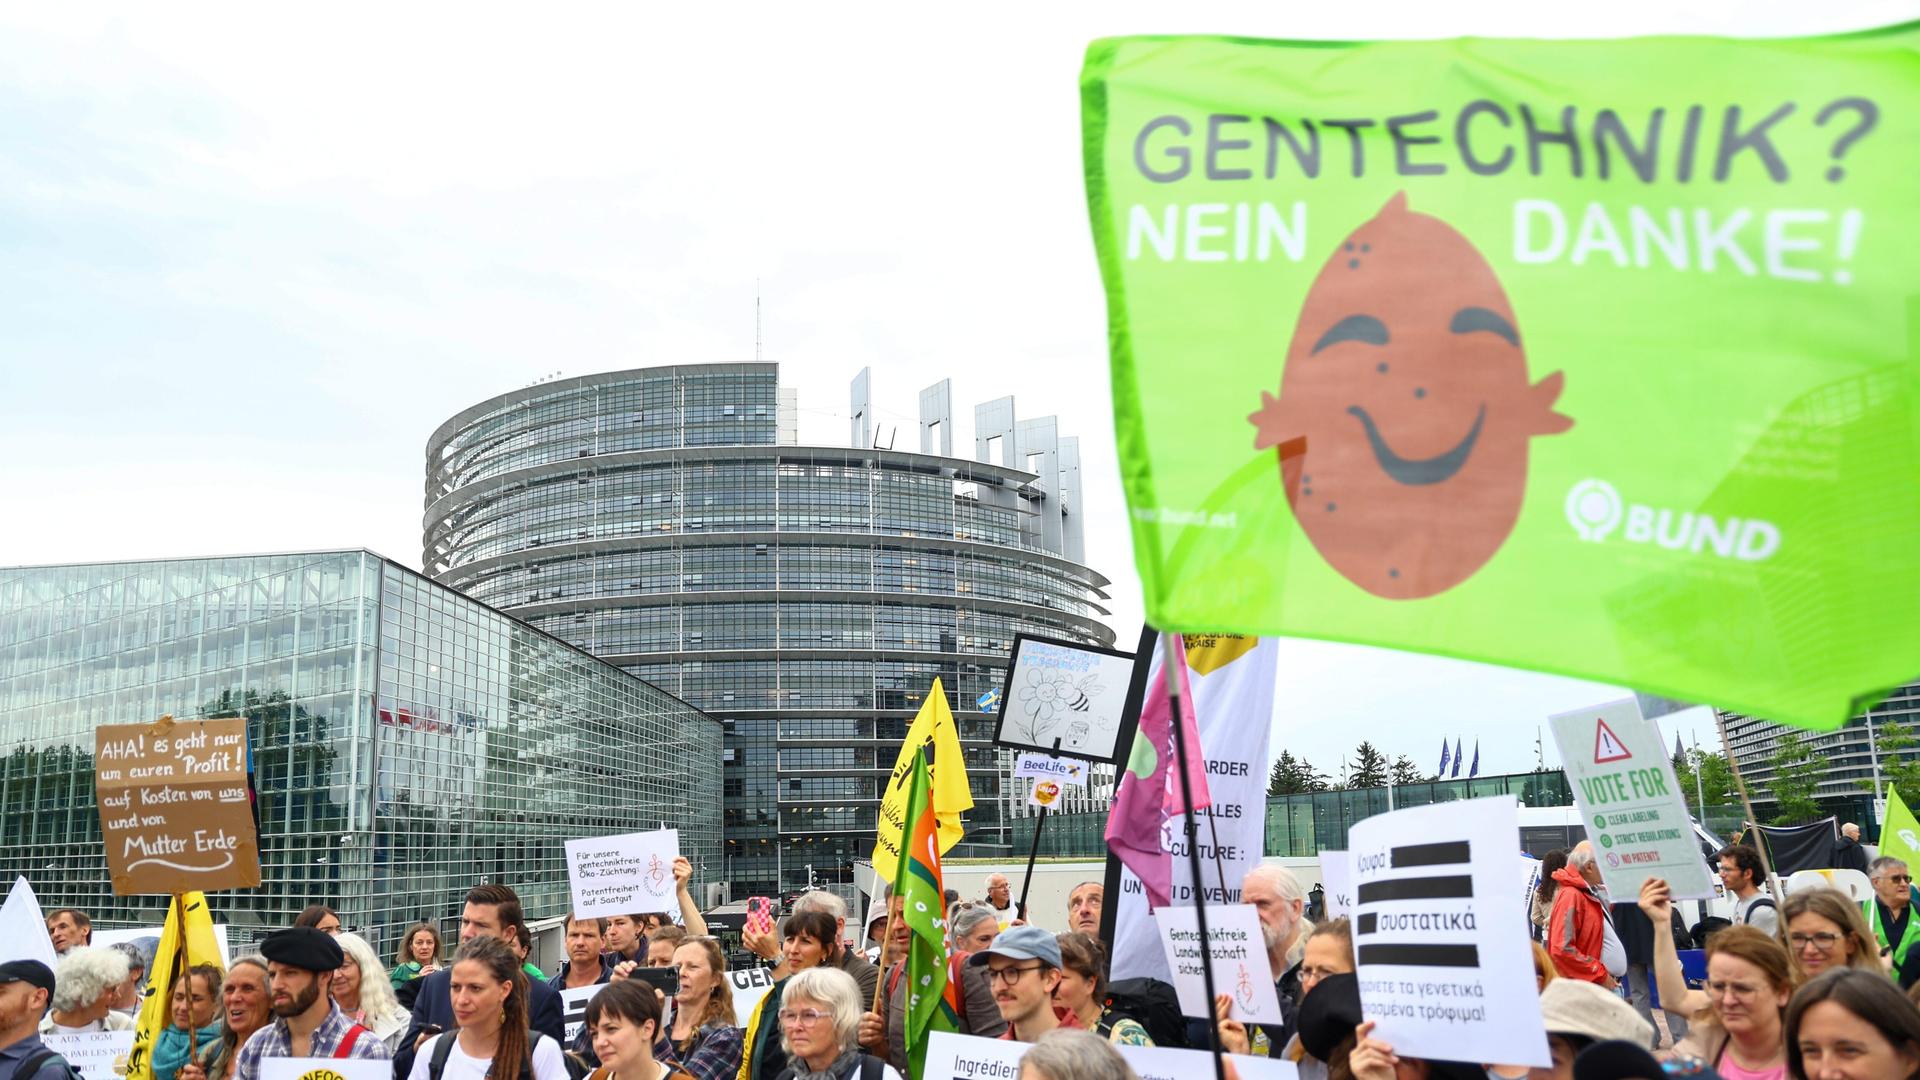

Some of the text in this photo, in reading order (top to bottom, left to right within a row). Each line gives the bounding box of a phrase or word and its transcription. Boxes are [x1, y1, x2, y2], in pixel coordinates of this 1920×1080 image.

[1132, 96, 1882, 186] GENTECHNIK?
[1125, 197, 1865, 285] NEIN DANKE!
[1625, 503, 1781, 561] BUND
[101, 730, 243, 760] AHA! es geht nur
[101, 746, 242, 780] um euren Profit!
[1023, 760, 1066, 774] BeeLife
[1579, 767, 1669, 806] VOTE FOR
[104, 785, 246, 809] auf Kosten von uns
[108, 812, 167, 830] und von
[1608, 810, 1660, 826] CLEAR LABELING
[123, 828, 238, 859] Mutter Erde
[1615, 829, 1681, 845] STRICT REGULATIONS
[576, 850, 620, 860] Für unsere
[578, 857, 640, 871] gentechnikfreie
[1621, 851, 1661, 864] NO PATENTS
[581, 885, 640, 897] Patentfreiheit
[582, 895, 633, 907] auf Saatgut
[1380, 906, 1477, 931] συστατικά
[60, 1036, 81, 1044] AUX
[90, 1034, 113, 1042] OGM
